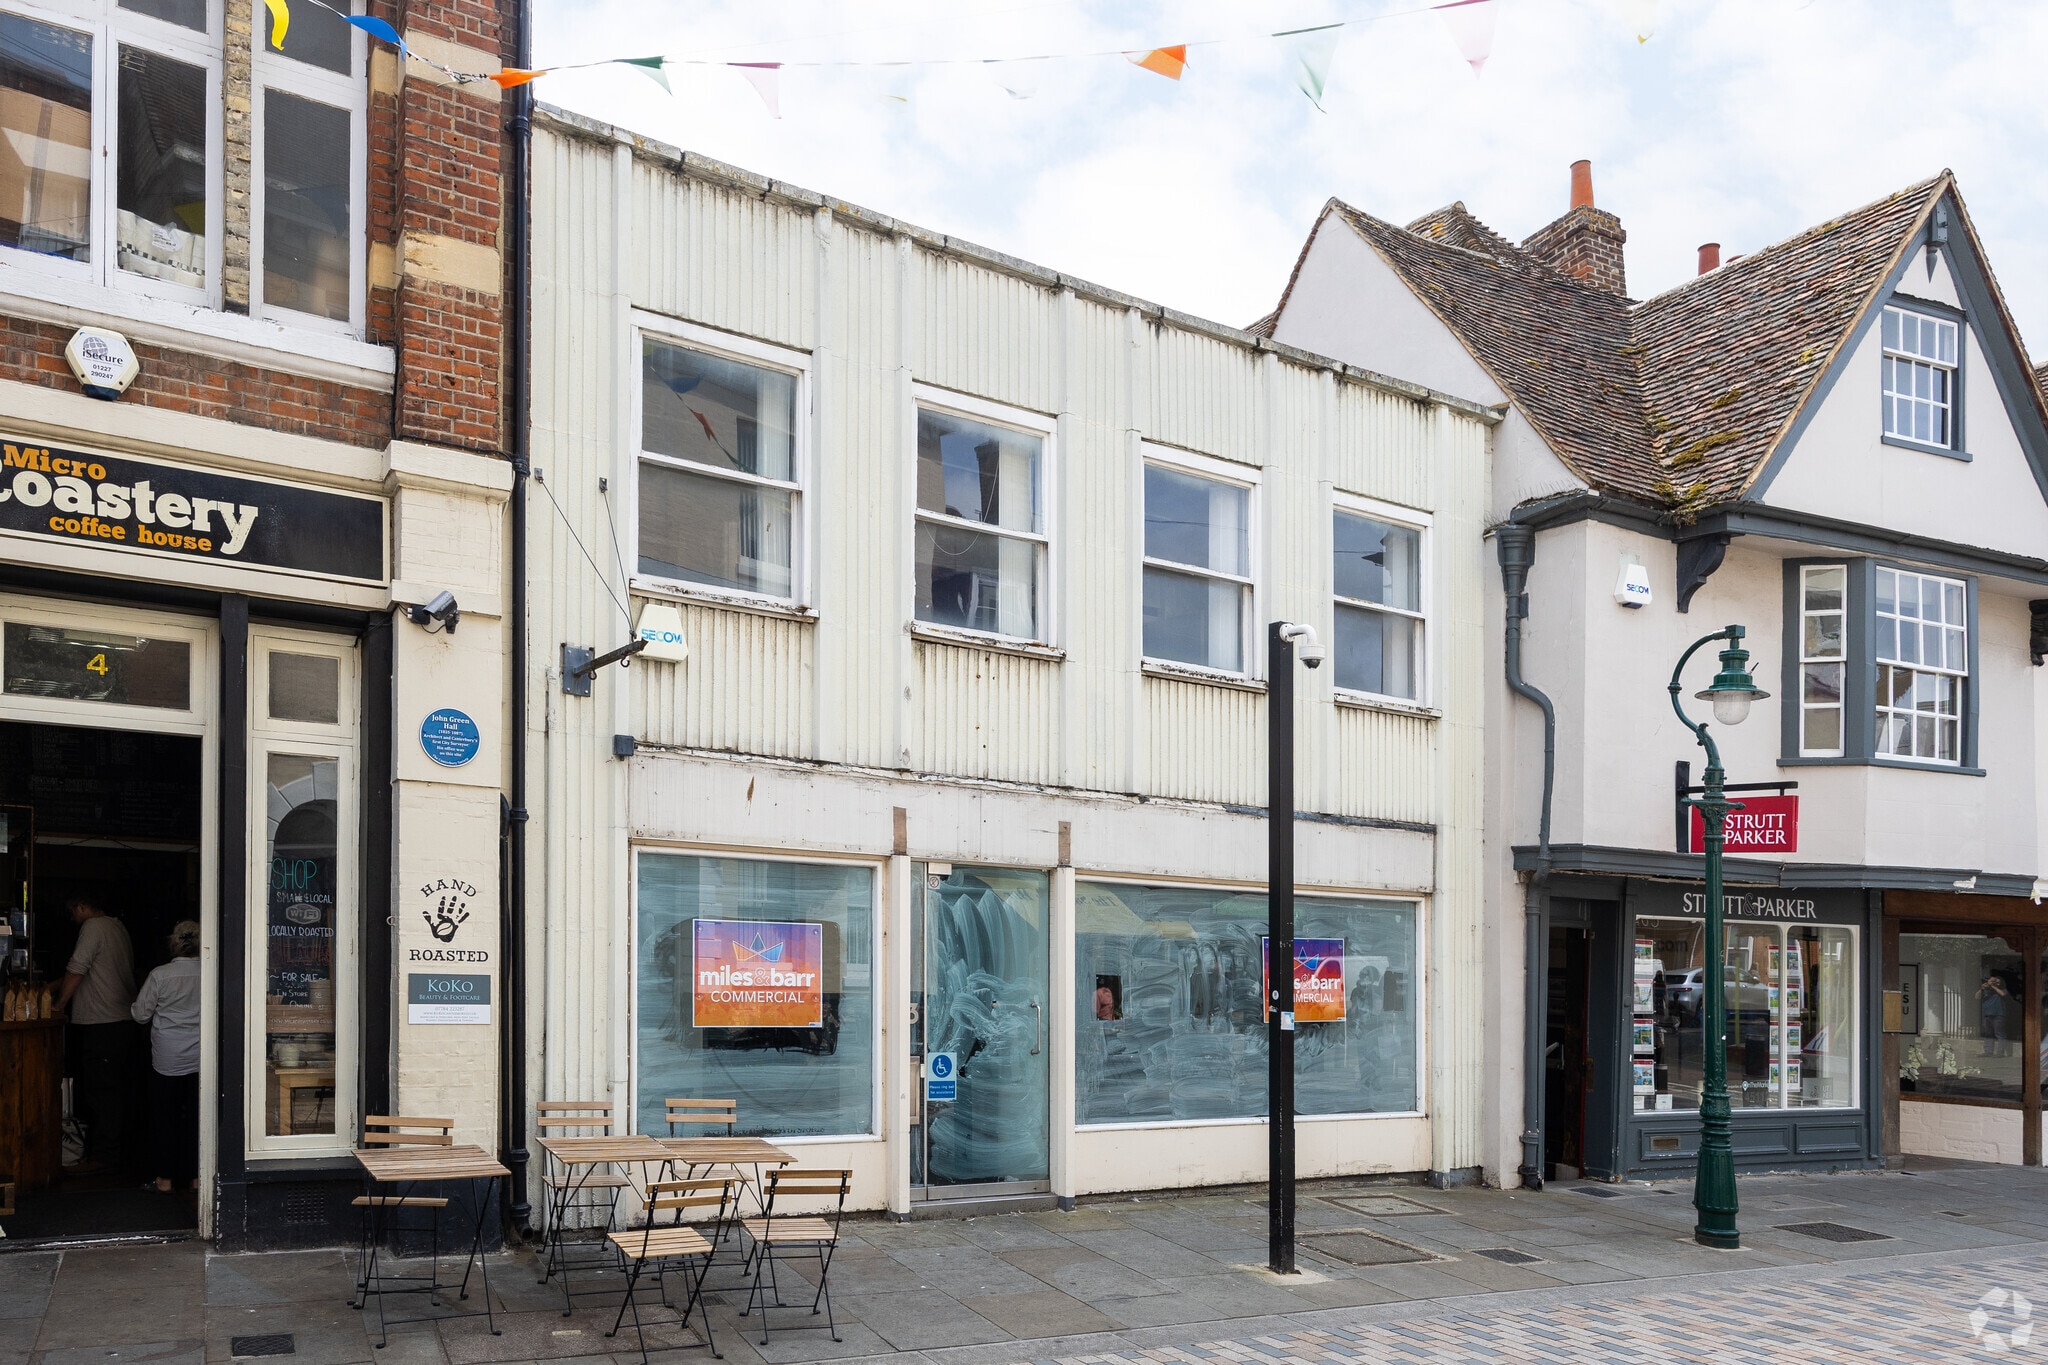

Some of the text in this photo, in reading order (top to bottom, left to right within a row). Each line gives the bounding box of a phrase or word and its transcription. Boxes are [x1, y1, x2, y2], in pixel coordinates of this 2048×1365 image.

[82, 347, 124, 365] iSecure
[90, 371, 114, 379] 290247
[92, 364, 112, 372] 01227
[3, 443, 106, 480] Micro
[0, 463, 259, 555] oastery
[49, 515, 212, 552] coffee house
[1626, 583, 1649, 594] SECOM
[641, 628, 683, 644] SECOM
[87, 653, 109, 676] 4
[431, 714, 470, 724] John Green
[1725, 813, 1787, 829] STRUTT
[272, 857, 317, 890] SHOP
[420, 879, 477, 898] HAND
[309, 893, 333, 904] LOCAL
[1683, 892, 1817, 919] STTT&PARKER
[298, 926, 334, 938] ROASTED
[409, 949, 489, 962] ROASTED
[281, 972, 318, 983] FOR SALE
[710, 990, 805, 1003] COMMERCIAL
[1293, 993, 1334, 1003] MERCIAL
